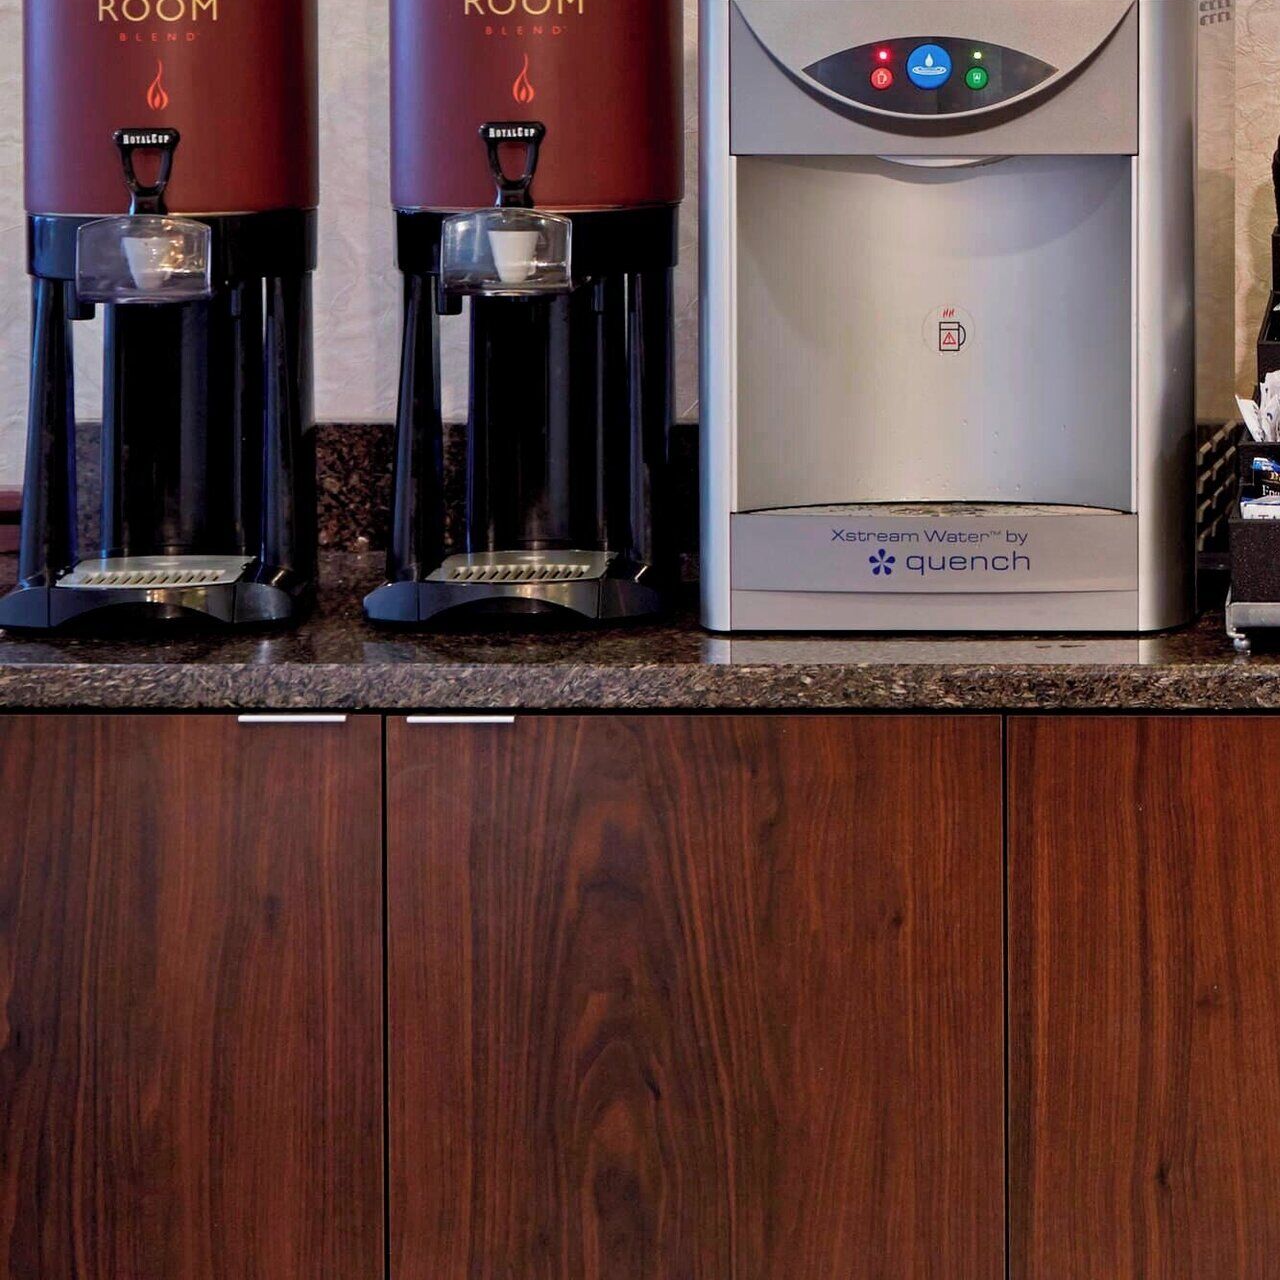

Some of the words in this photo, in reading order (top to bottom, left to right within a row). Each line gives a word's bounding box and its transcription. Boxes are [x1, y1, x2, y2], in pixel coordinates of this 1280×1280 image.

[484, 25, 563, 35] BLEND
[119, 32, 196, 42] BLEND
[831, 529, 919, 542] Xstream
[1006, 530, 1029, 546] by
[906, 550, 1031, 576] quench
